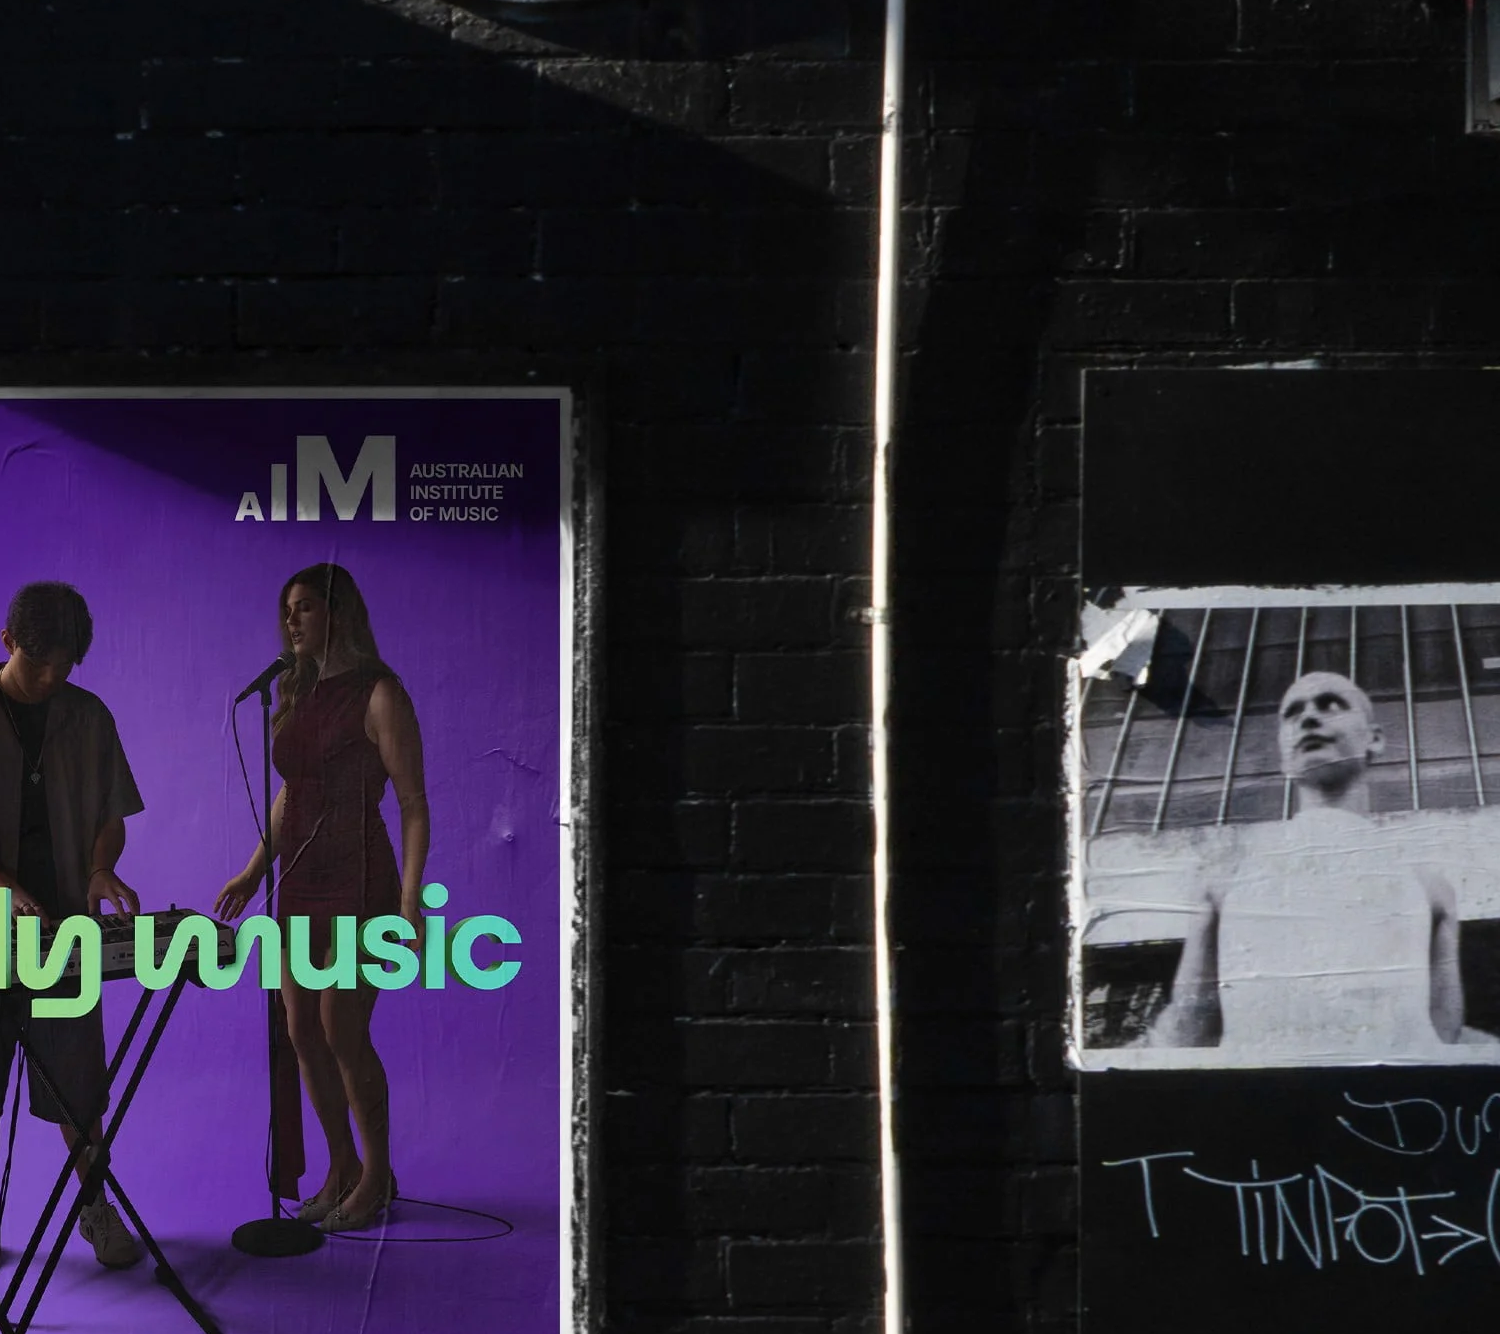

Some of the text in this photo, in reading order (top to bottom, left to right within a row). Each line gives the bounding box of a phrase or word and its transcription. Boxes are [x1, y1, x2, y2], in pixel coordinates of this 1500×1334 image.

[235, 435, 396, 521] AIM
[409, 464, 524, 478] AUSTRALIAN
[410, 485, 504, 500] INSTITUTE
[409, 507, 499, 522] OF MUSIC
[135, 882, 523, 991] music
